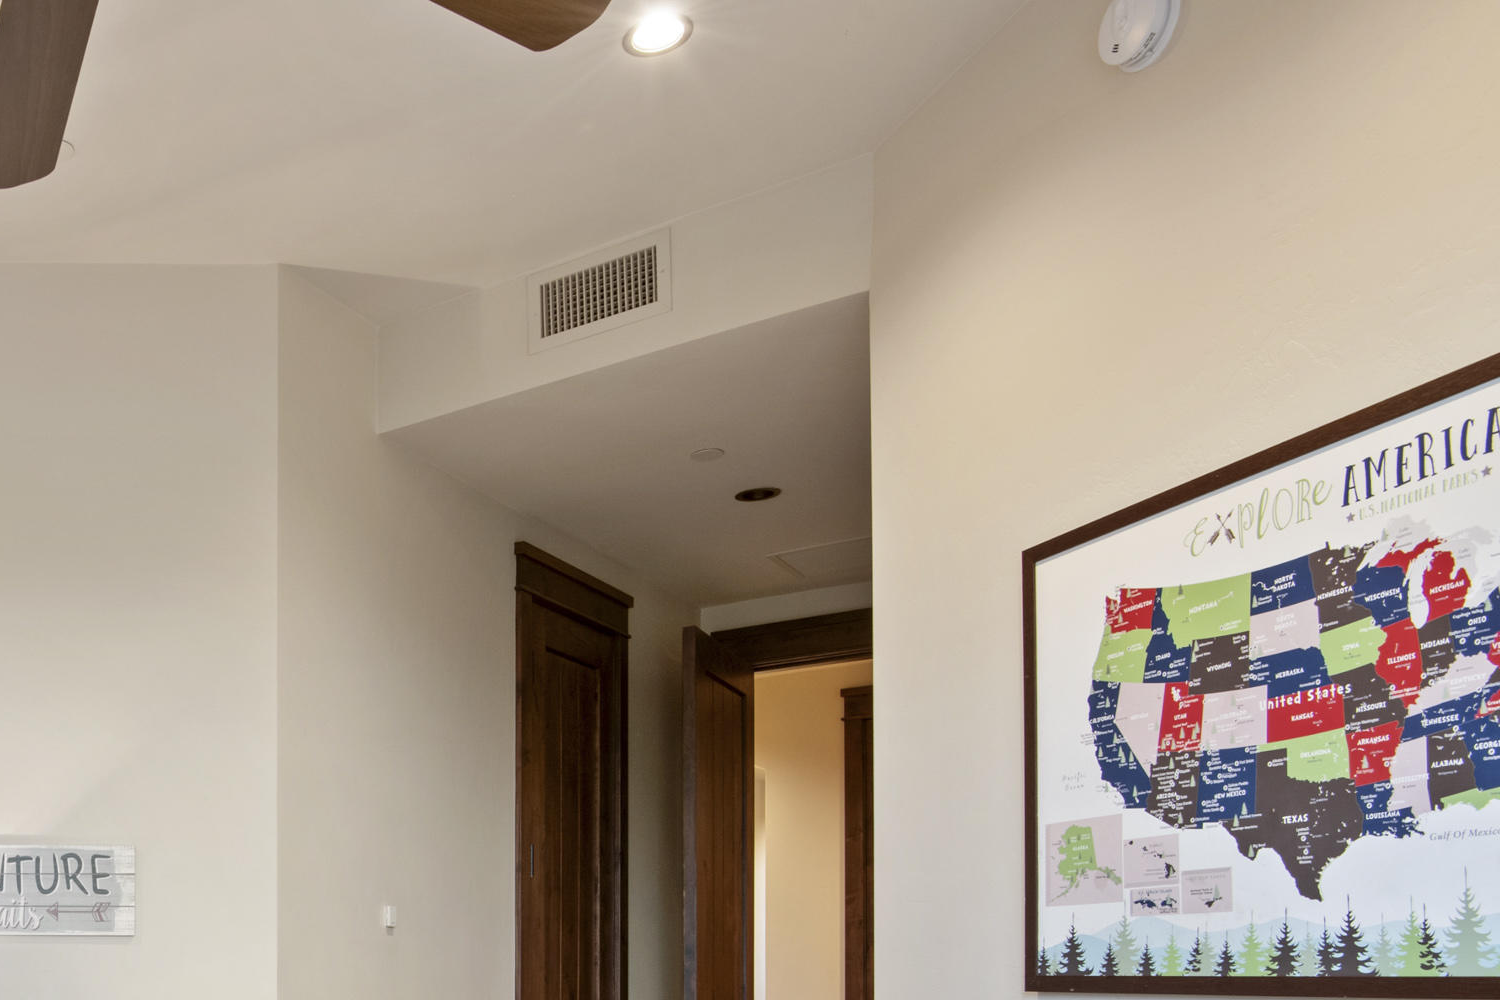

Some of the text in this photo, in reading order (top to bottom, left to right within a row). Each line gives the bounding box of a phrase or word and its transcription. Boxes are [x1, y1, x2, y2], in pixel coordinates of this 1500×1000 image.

[1341, 406, 1500, 507] AMERICA
[1442, 468, 1479, 493] PARKS
[1273, 573, 1296, 592] NORTH DAKOTA
[1429, 580, 1465, 595] MICHIGAN
[1317, 585, 1353, 601] MINNESOTA
[1364, 587, 1400, 602] WISCONSIN
[1123, 600, 1152, 613] WASHINGTON
[1189, 600, 1218, 614] MONTANA
[1468, 616, 1487, 626] OHIO
[1420, 637, 1451, 650] INDIANA
[1387, 652, 1417, 665] ILLINOIS
[1206, 661, 1232, 672] WYOMING
[1275, 667, 1305, 679] NEBRASKA
[1259, 683, 1352, 711] United States
[1356, 701, 1387, 713] MISSOURI
[1291, 711, 1314, 722] KANSAS
[1421, 713, 1460, 726] TENNESSEE
[1357, 734, 1390, 746] ARKANSAS
[1431, 758, 1464, 769] ALABAMA
[1214, 790, 1246, 800] NEW MEXICO
[1282, 813, 1308, 824] TEXAS
[1366, 810, 1401, 820] LOUISIANA
[1430, 831, 1450, 841] Gulf
[1453, 830, 1465, 840] Of
